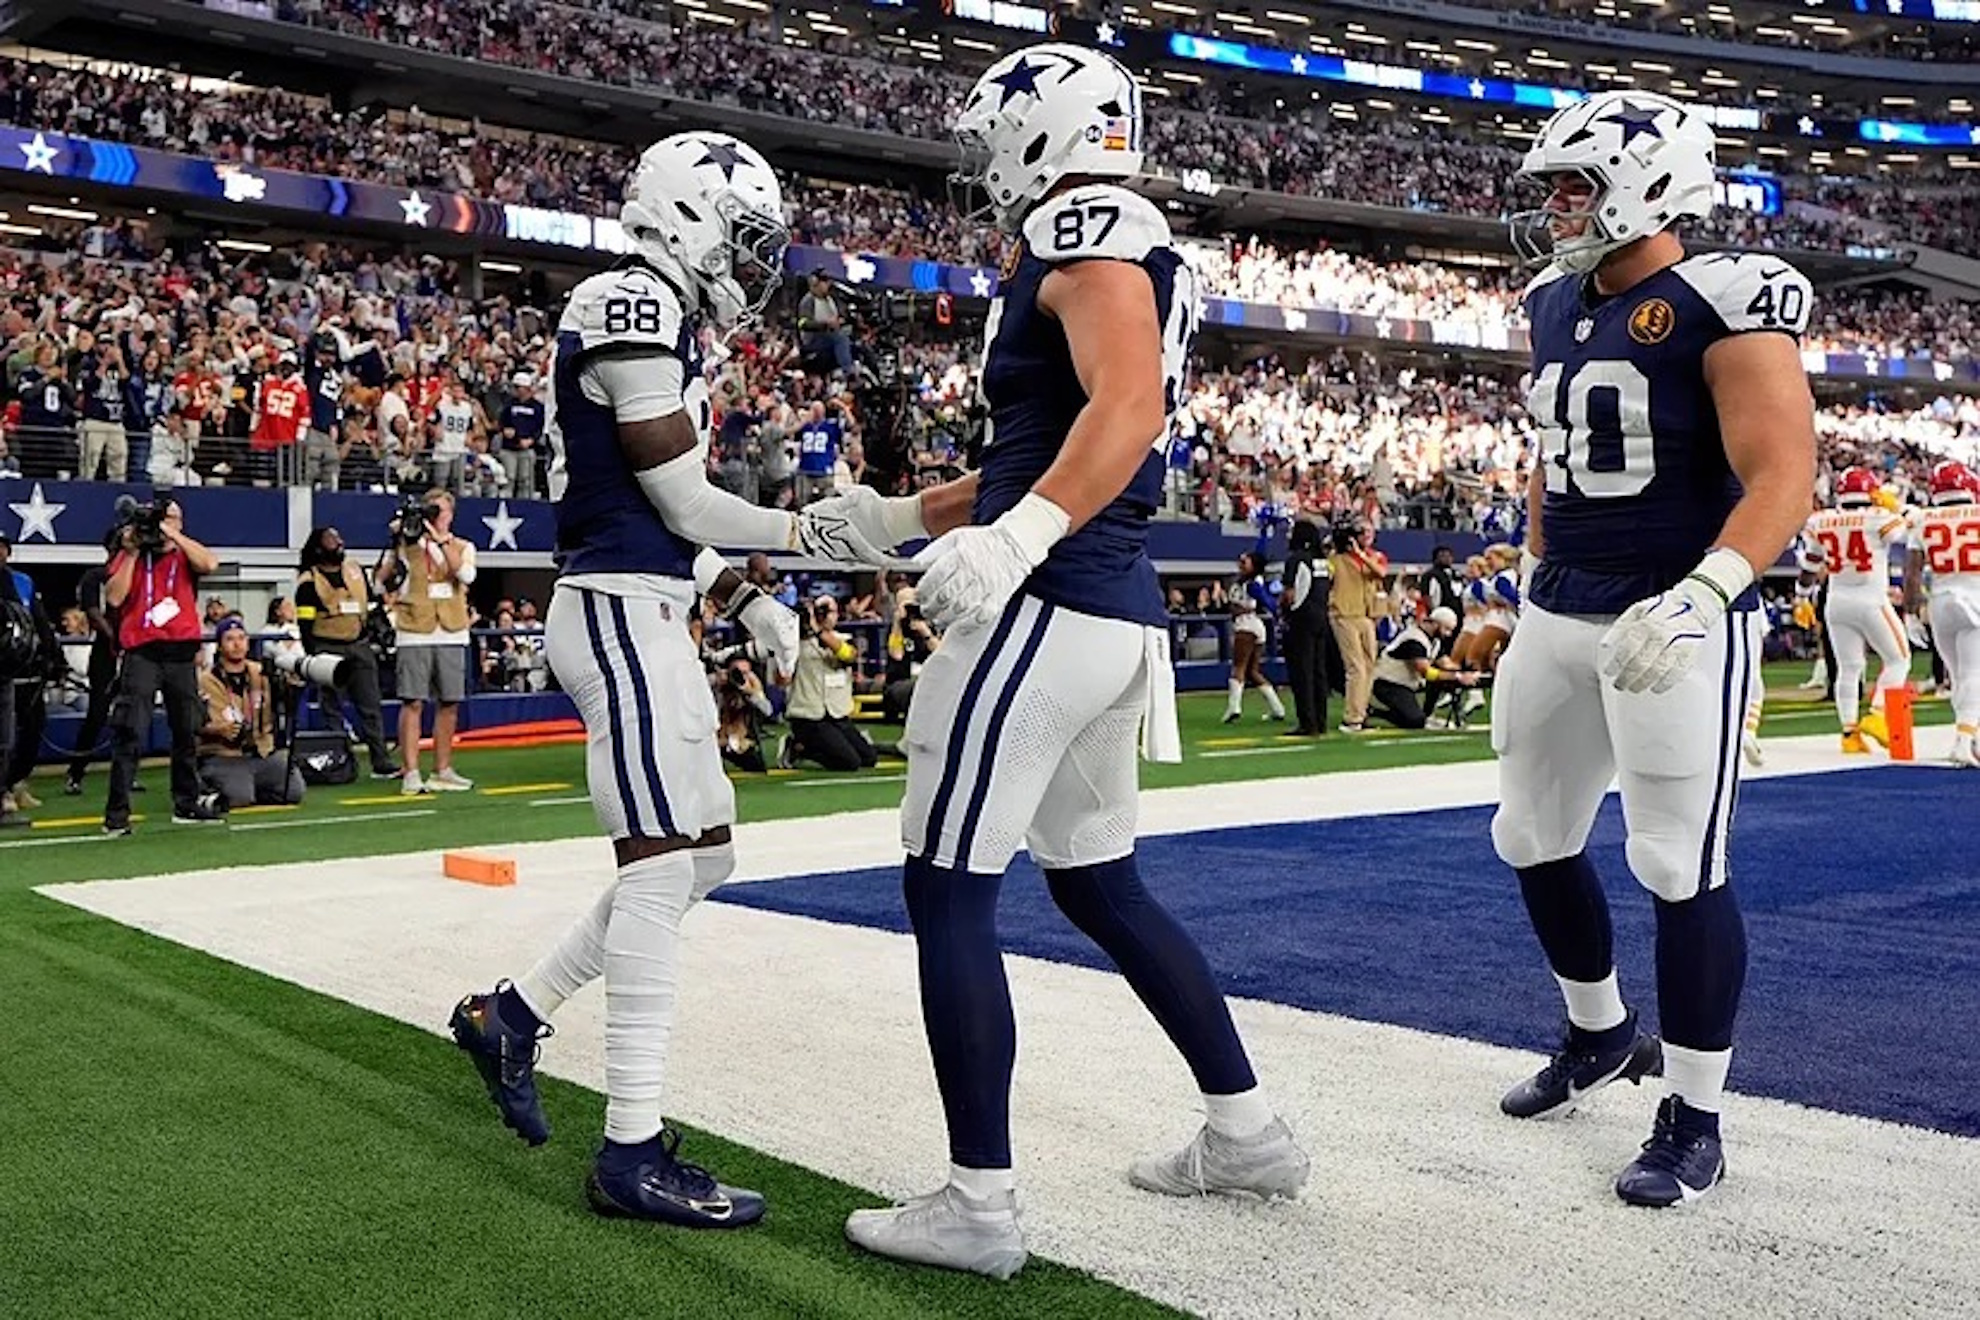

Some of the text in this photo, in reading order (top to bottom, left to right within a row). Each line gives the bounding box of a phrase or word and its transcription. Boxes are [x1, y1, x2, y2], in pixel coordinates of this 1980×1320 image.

[1053, 206, 1120, 250] 87
[605, 299, 660, 333] 88
[1746, 284, 1803, 325] 40
[266, 389, 297, 418] 52
[802, 431, 829, 454] 22
[1817, 530, 1873, 574] 34
[1923, 523, 1980, 573] 22
